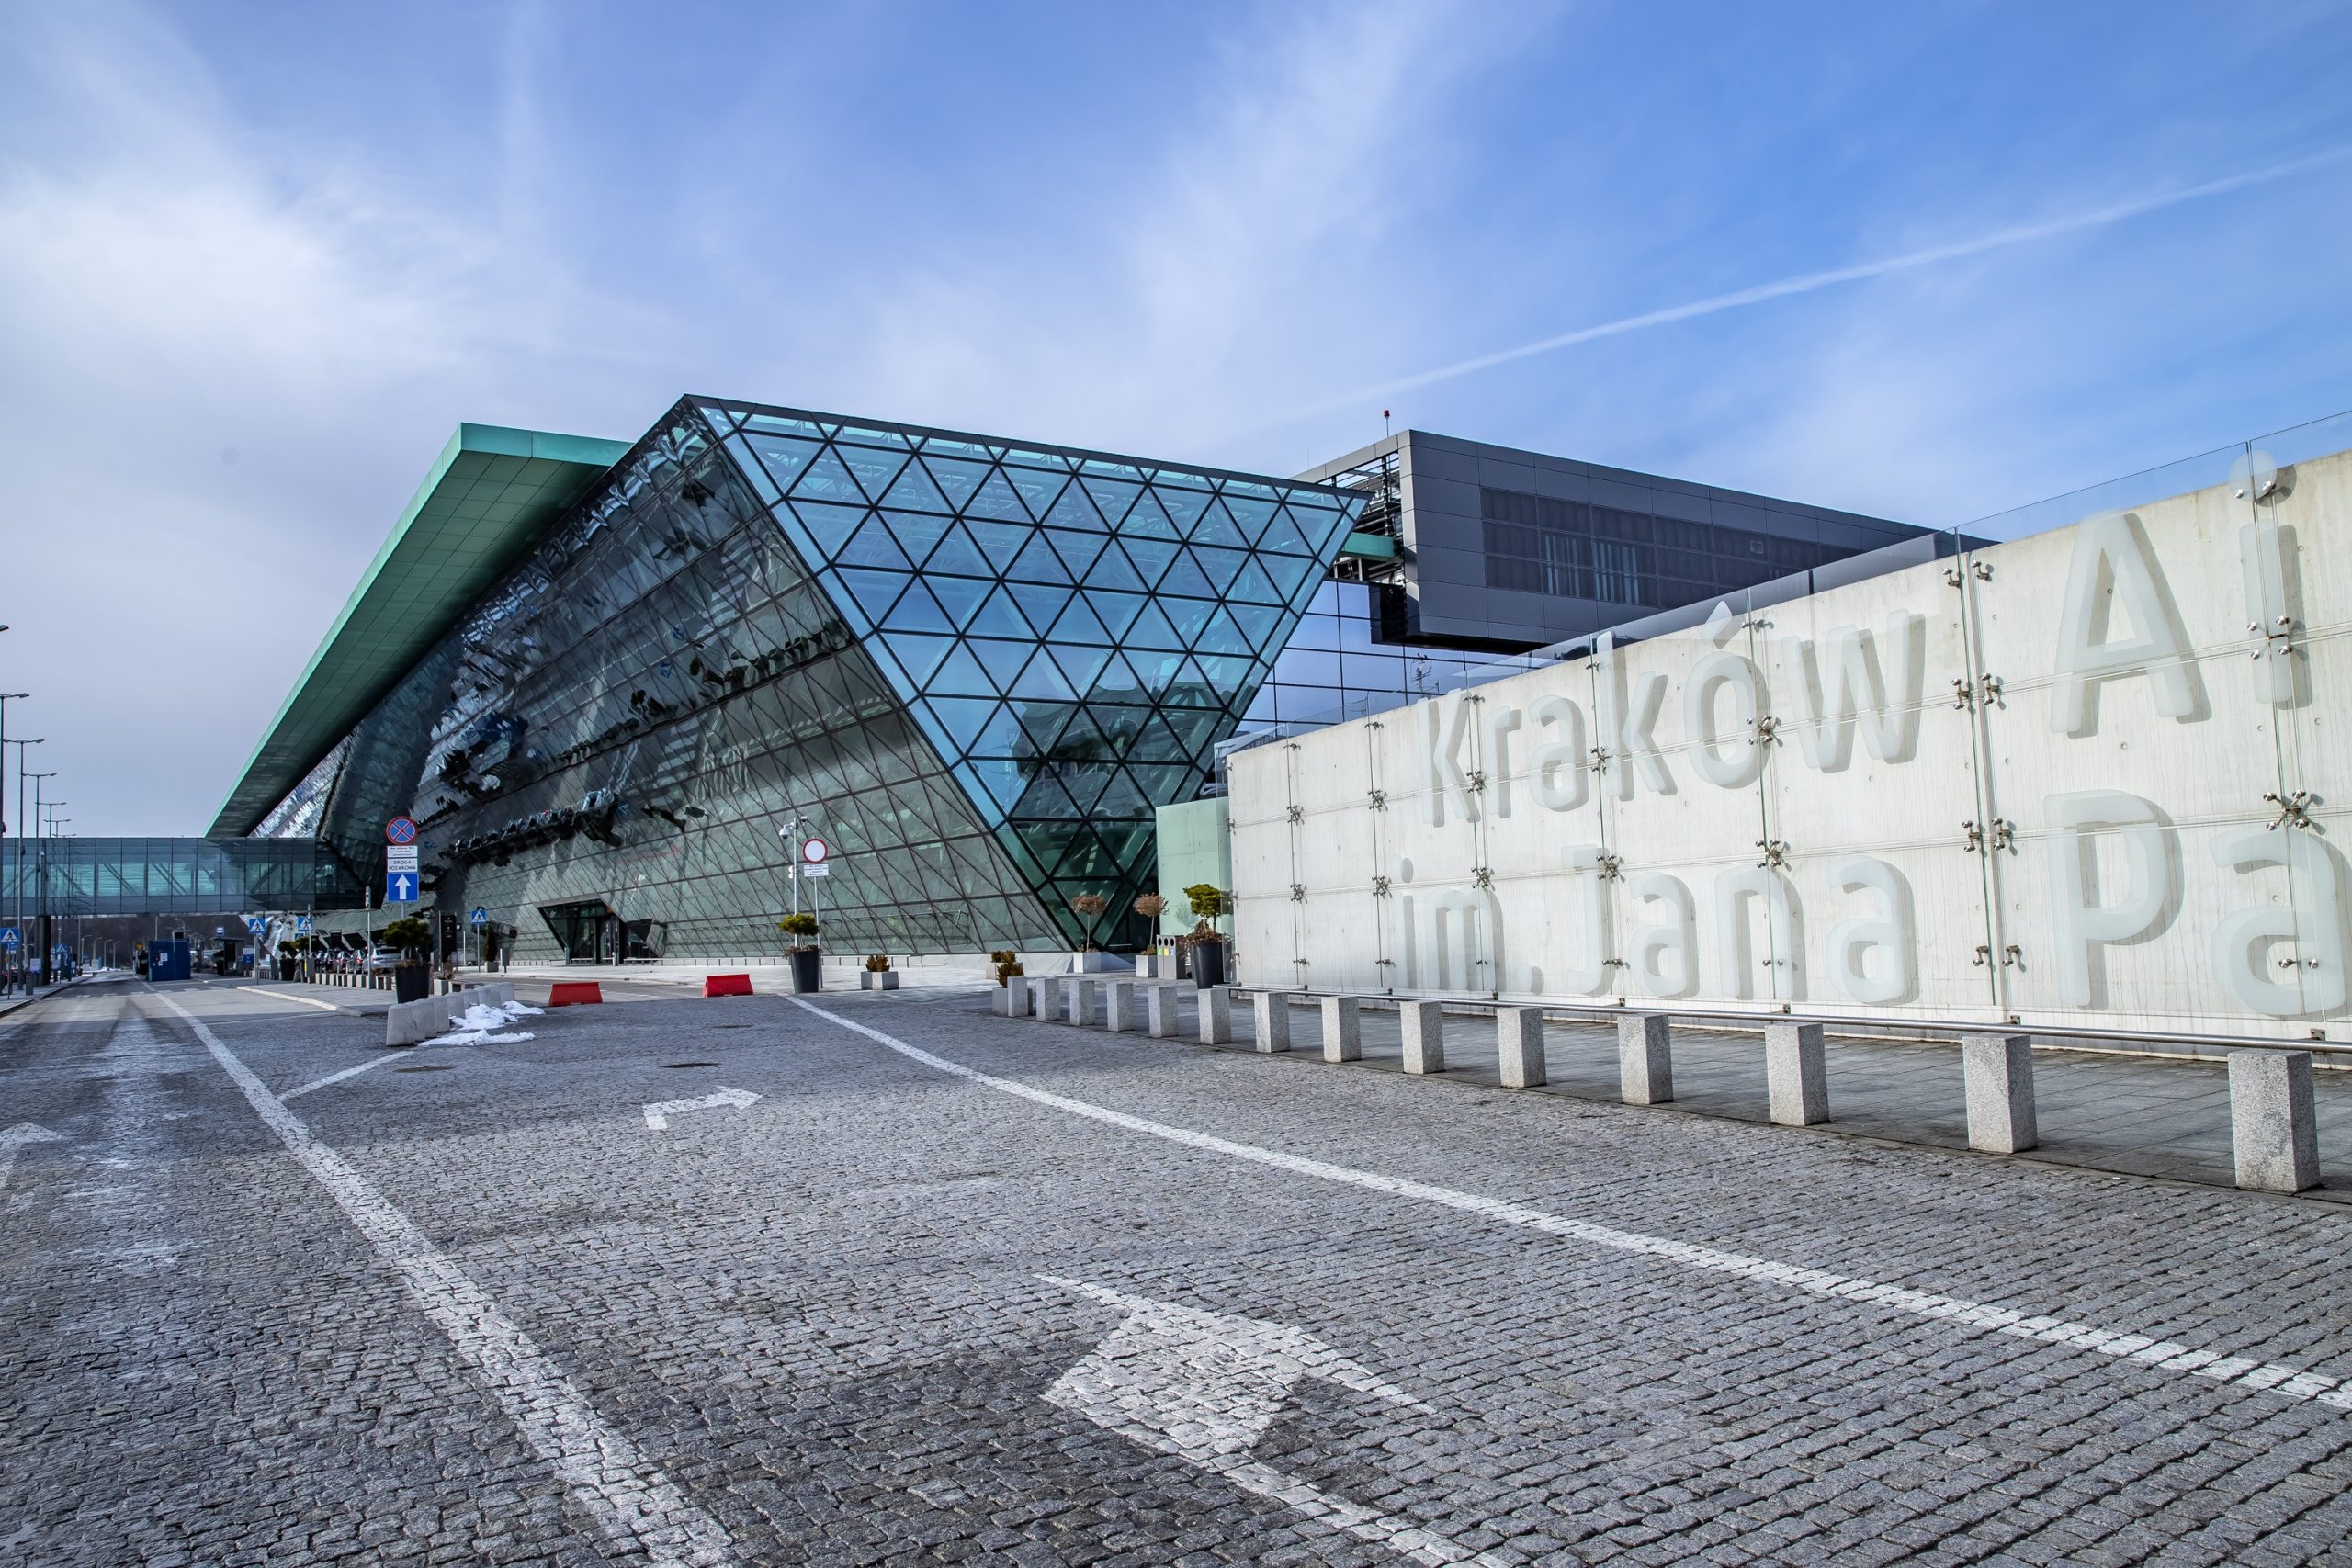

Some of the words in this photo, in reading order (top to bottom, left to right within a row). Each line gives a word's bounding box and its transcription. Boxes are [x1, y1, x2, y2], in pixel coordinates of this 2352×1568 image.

[1416, 600, 1911, 825] Kraków
[2050, 449, 2291, 733] Ai
[1391, 857, 1533, 992] im.
[1561, 844, 1905, 1003] Jana
[2044, 790, 2346, 1015] Pa
